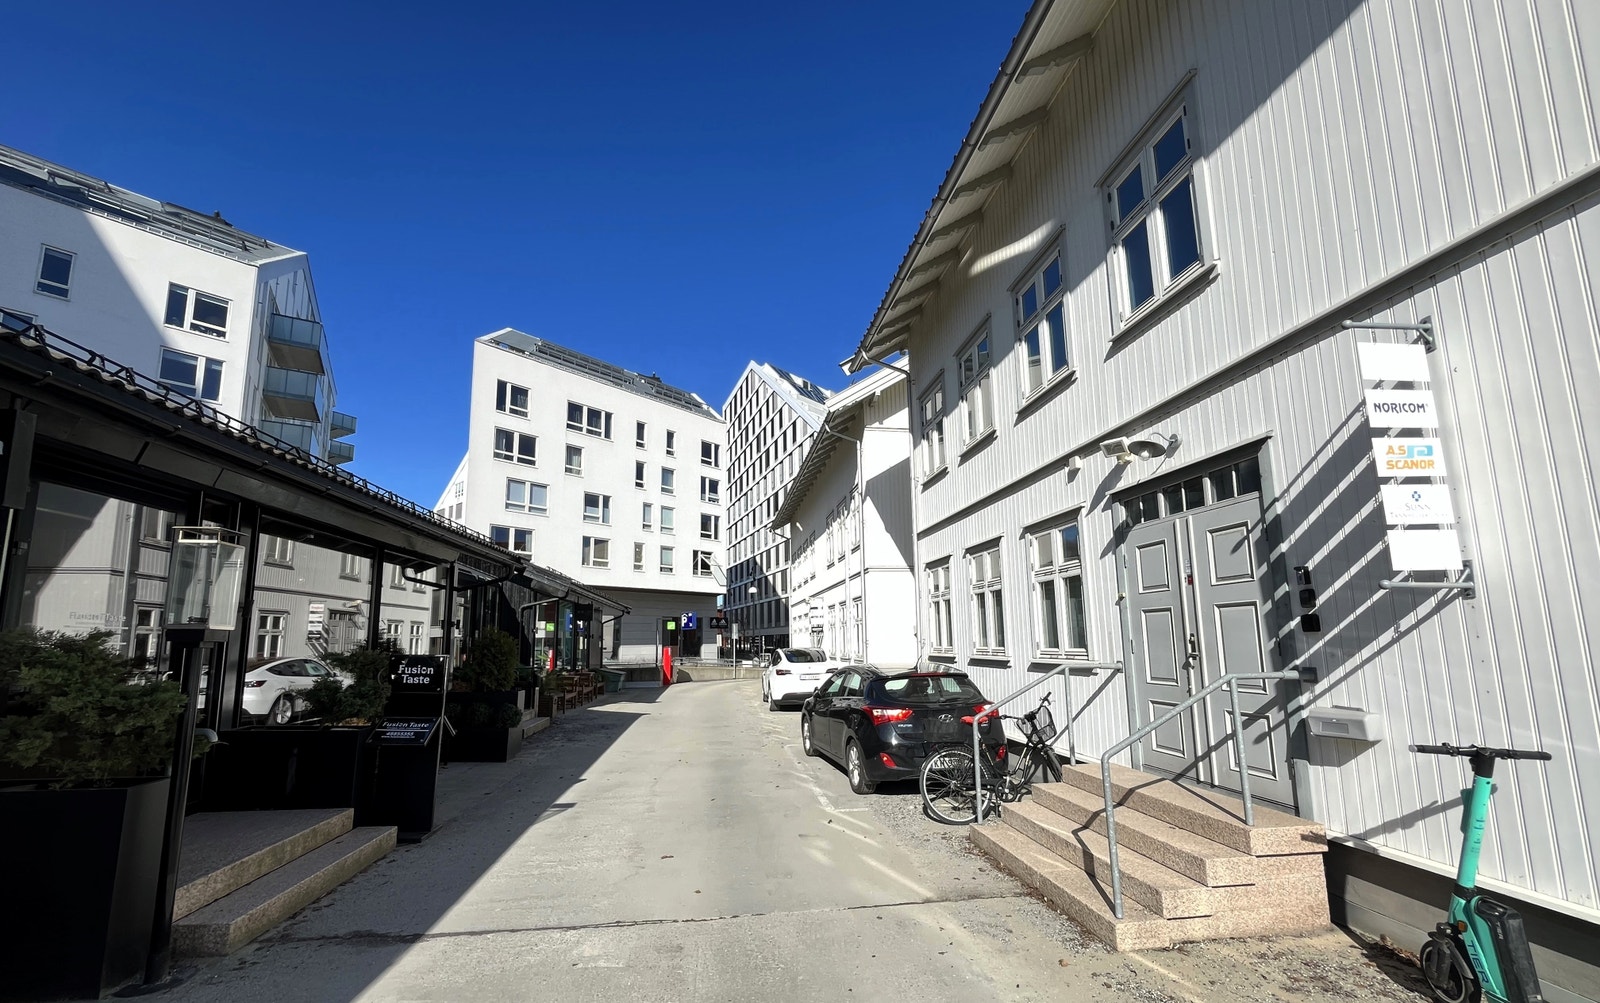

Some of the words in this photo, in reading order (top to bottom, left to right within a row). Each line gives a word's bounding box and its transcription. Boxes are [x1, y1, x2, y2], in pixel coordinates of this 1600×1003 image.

[1373, 403, 1426, 413] NORICOM
[1386, 460, 1435, 469] SCANOR
[397, 665, 434, 674] Fusion
[402, 675, 430, 684] Taste
[1467, 940, 1490, 983] TIER
